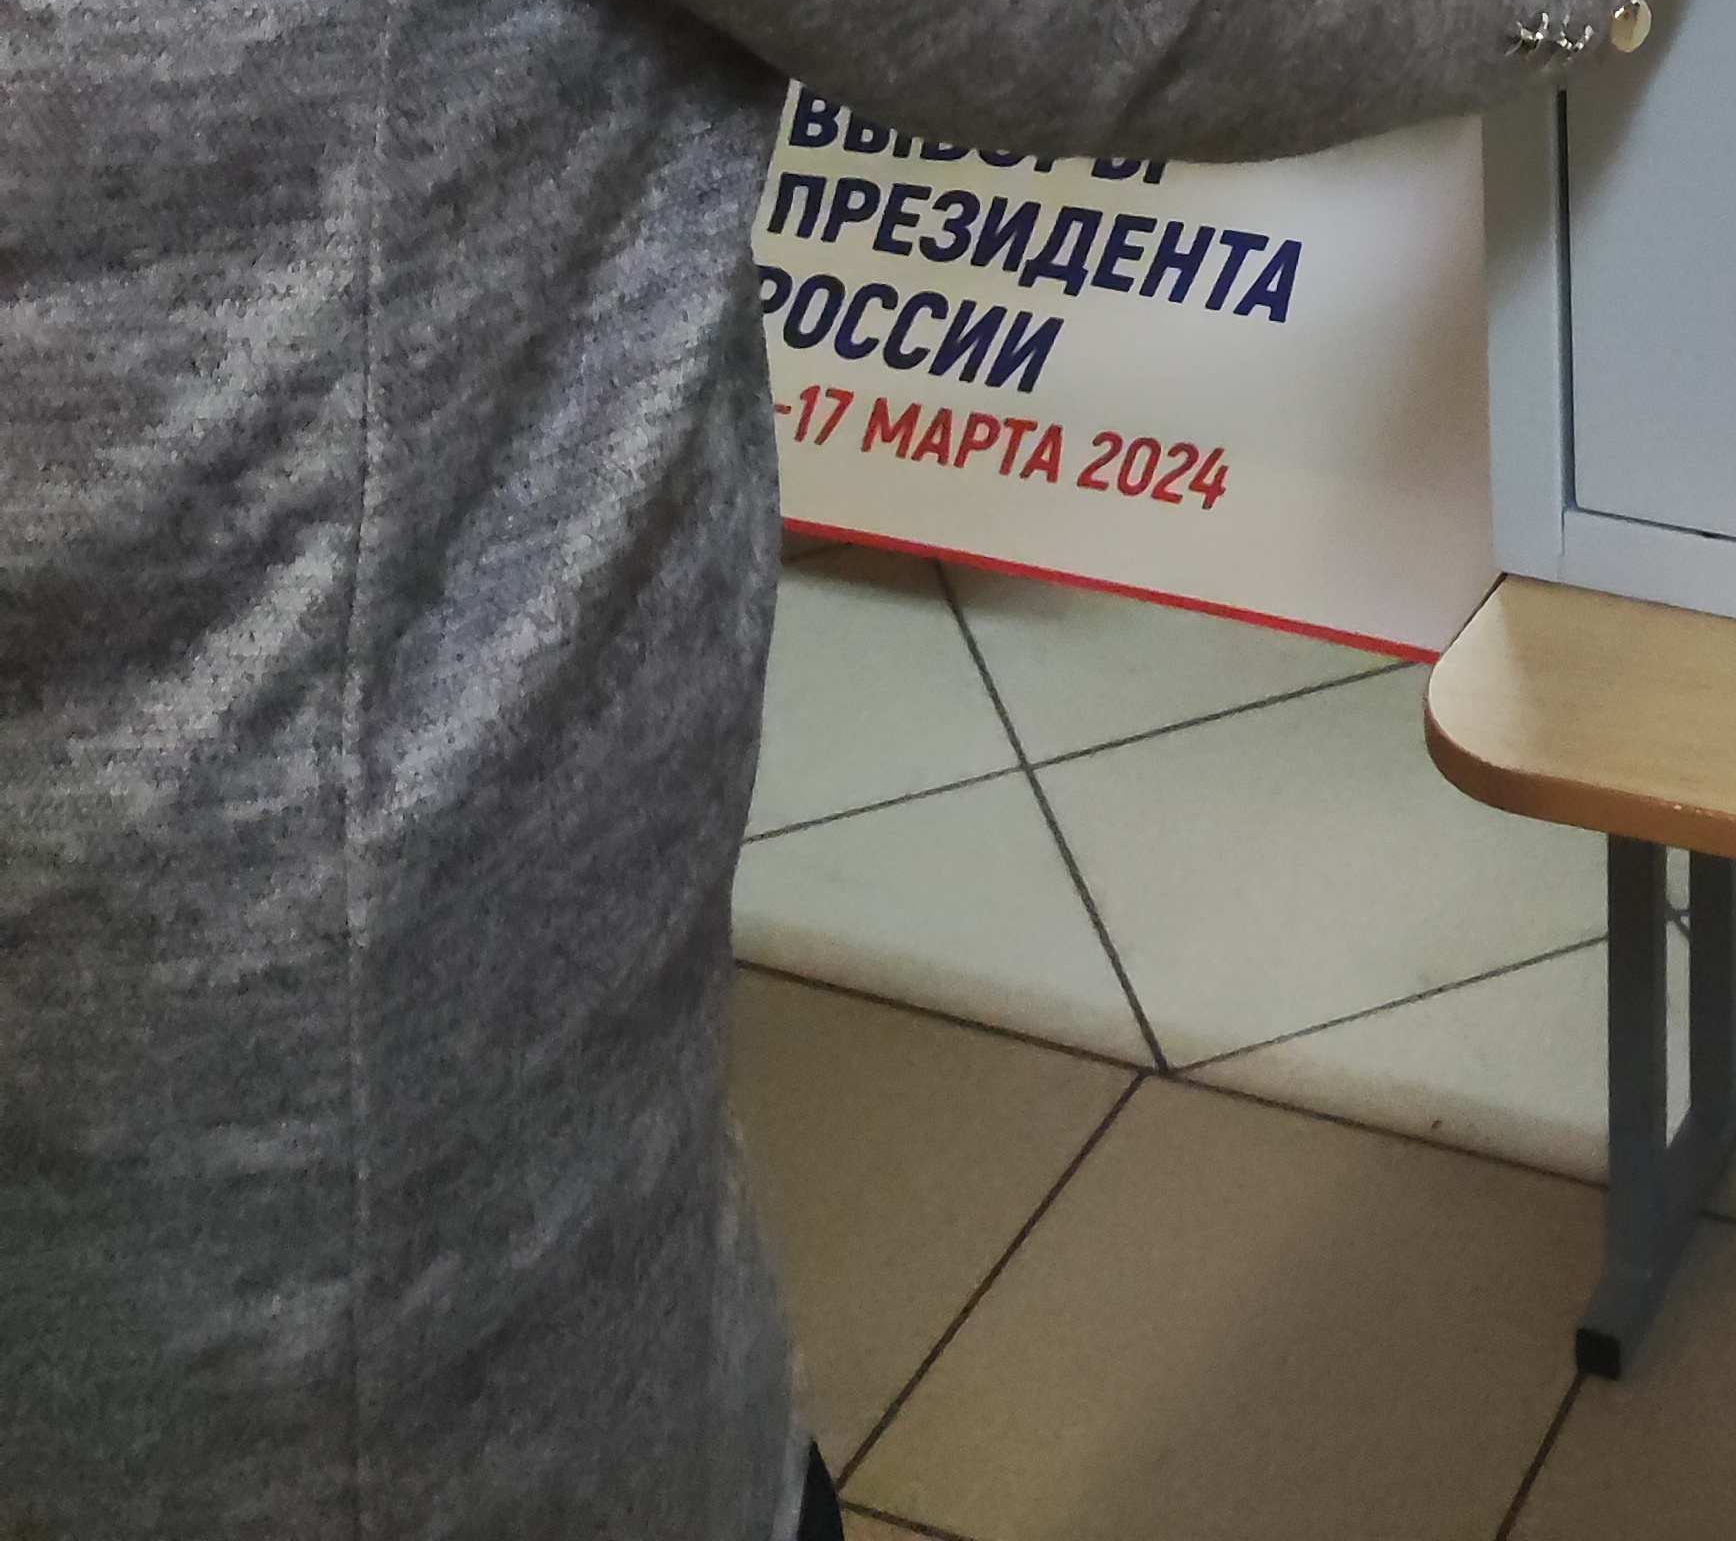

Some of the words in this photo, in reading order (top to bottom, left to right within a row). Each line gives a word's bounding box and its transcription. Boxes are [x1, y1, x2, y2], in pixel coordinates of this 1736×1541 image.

[767, 172, 1303, 324] ПРЕЗИДЕНТА
[757, 264, 1065, 395] РОССИИ
[860, 396, 1064, 484] МАРТА
[1076, 430, 1228, 511] 2024
